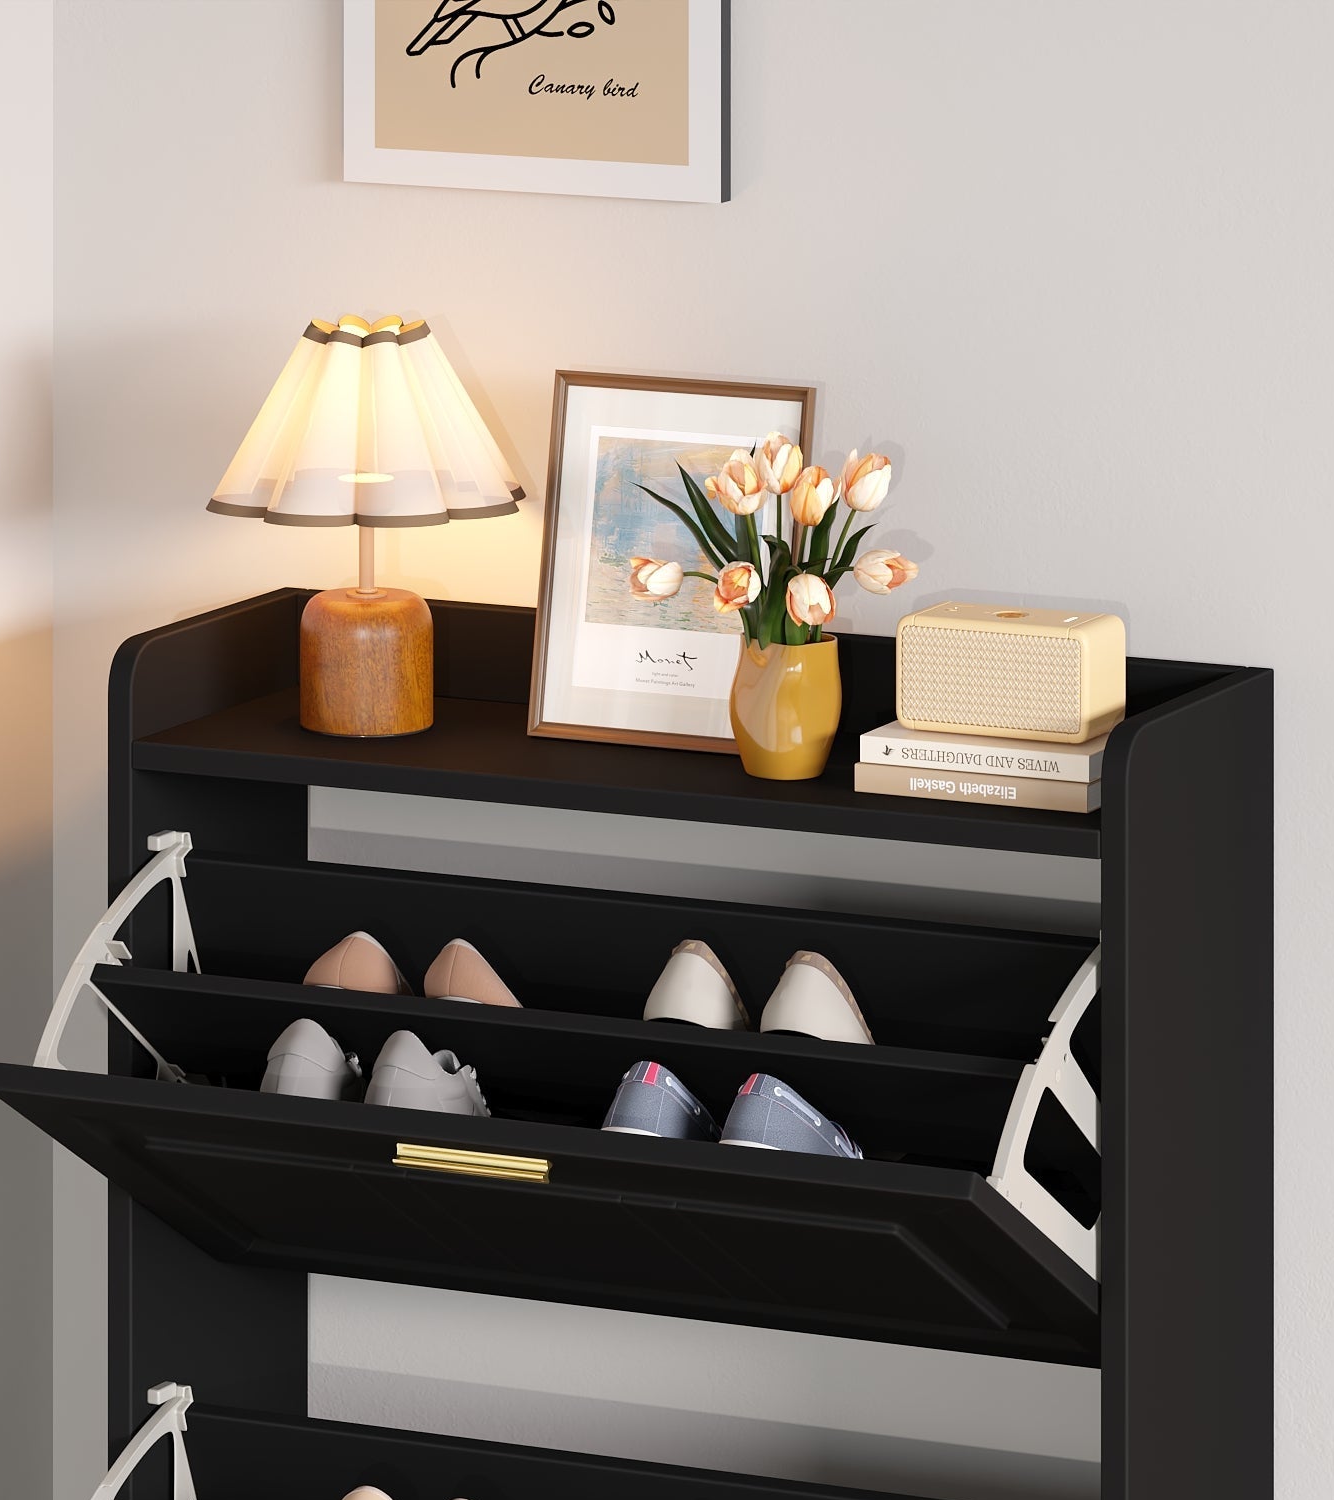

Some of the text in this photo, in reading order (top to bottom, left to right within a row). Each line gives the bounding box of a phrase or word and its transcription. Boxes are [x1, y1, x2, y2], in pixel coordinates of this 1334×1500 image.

[528, 74, 640, 100] Canary bird
[635, 649, 698, 671] Monet
[901, 747, 1061, 773] WIVES AND DAUGHTERS
[909, 777, 1017, 800] Elizabeth Gaskell
